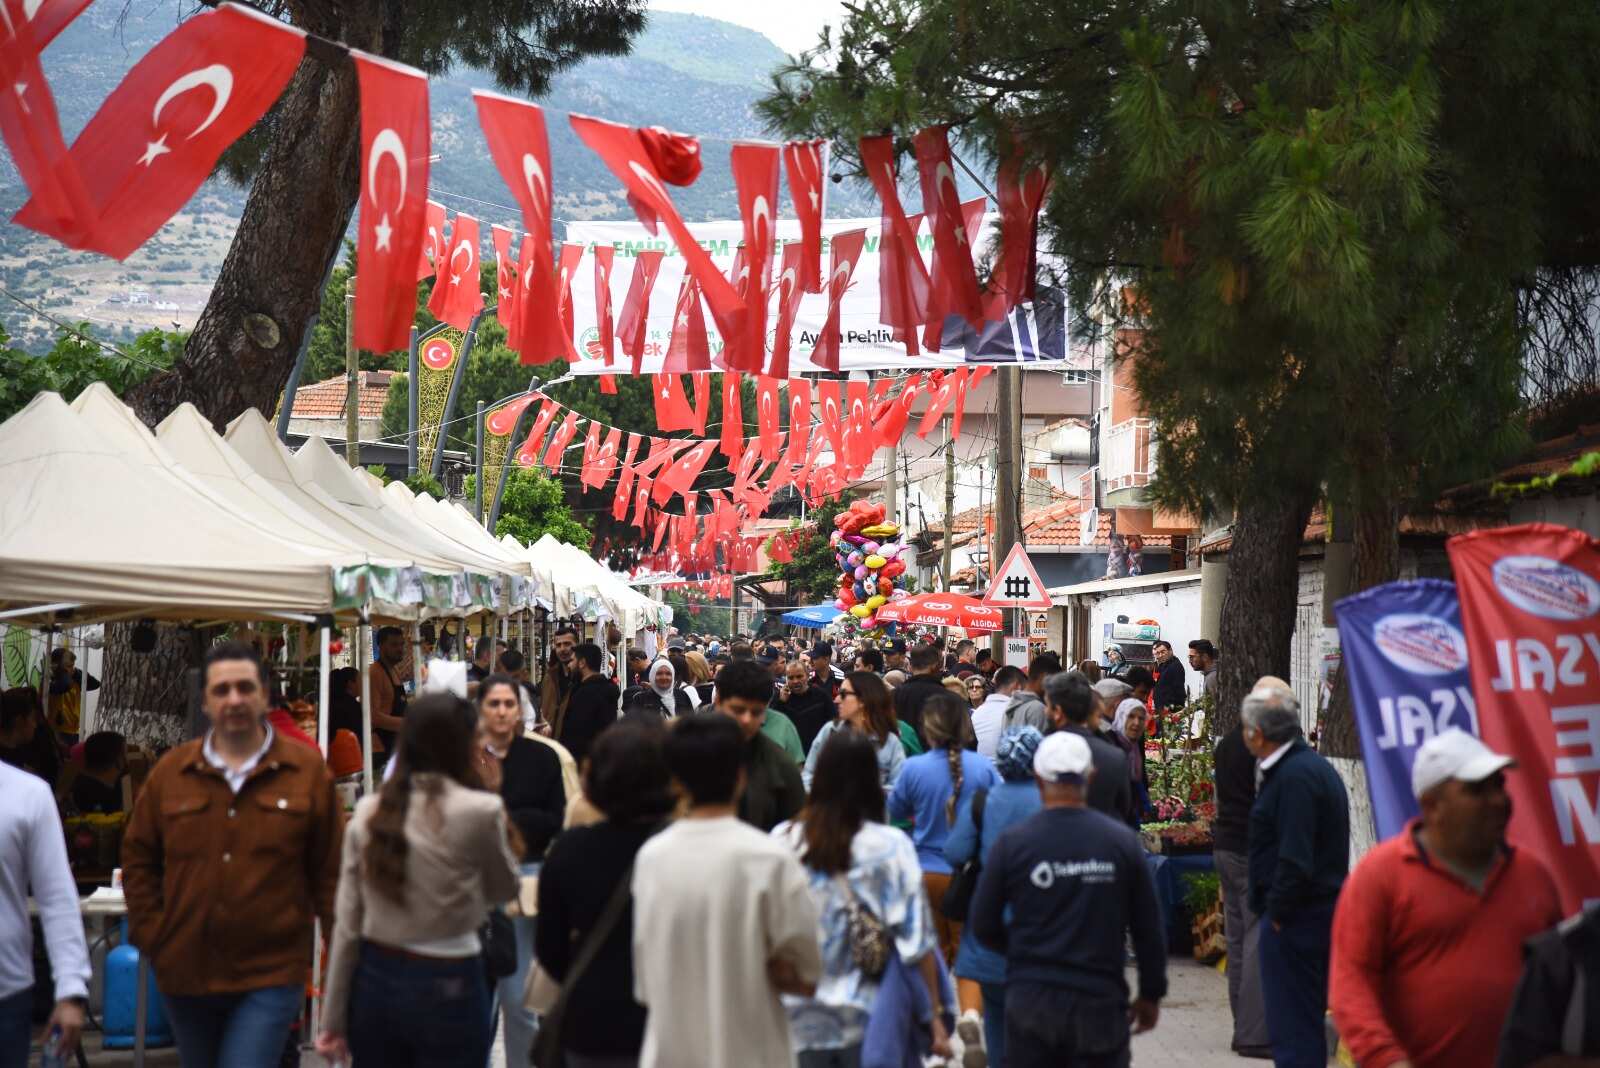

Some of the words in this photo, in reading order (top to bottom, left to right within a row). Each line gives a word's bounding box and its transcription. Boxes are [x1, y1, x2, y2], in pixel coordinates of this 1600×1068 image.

[613, 237, 729, 258] EMİRAEM
[847, 329, 895, 344] Pehliv
[916, 615, 946, 625] ALGIDA
[970, 619, 998, 629] ALGIDA
[1007, 642, 1026, 653] 300m
